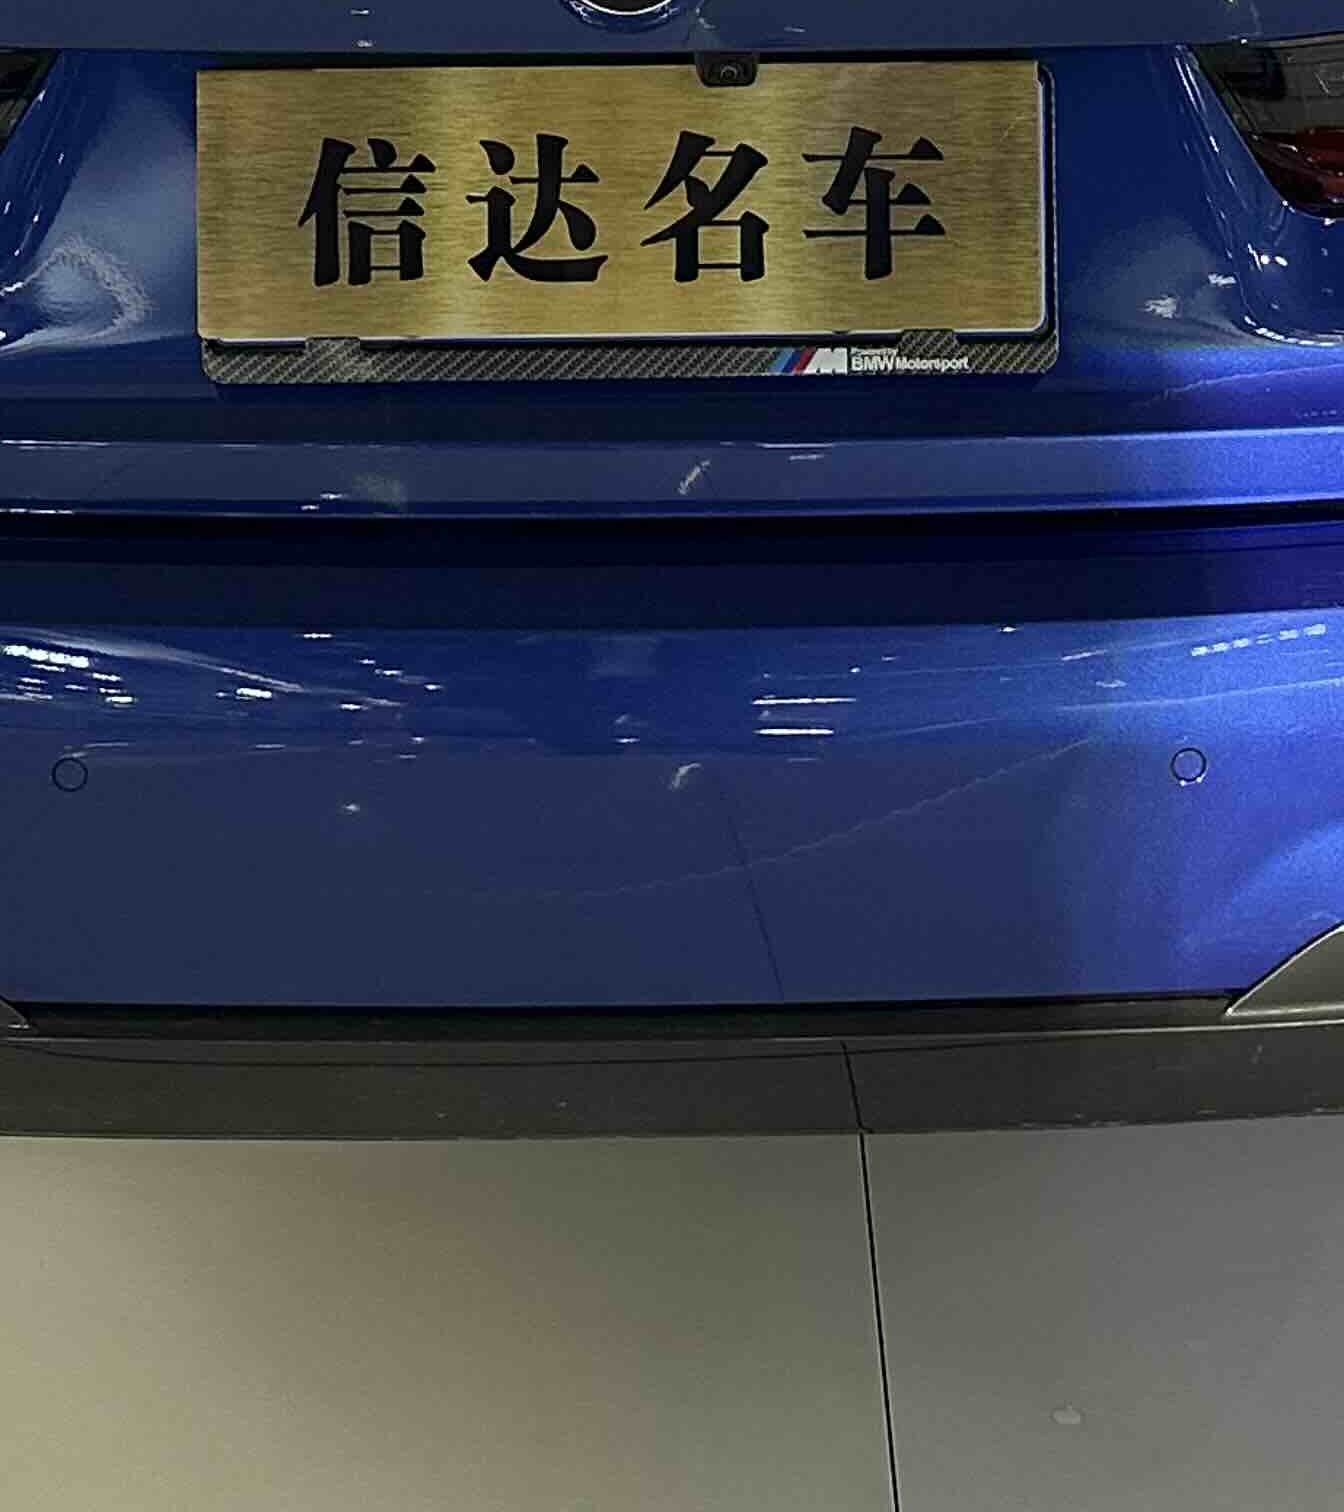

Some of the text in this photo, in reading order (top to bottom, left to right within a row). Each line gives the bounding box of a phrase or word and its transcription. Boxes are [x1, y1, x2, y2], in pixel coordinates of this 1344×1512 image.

[297, 126, 947, 288] 信达名车
[850, 355, 970, 373] BMW Motorsport
